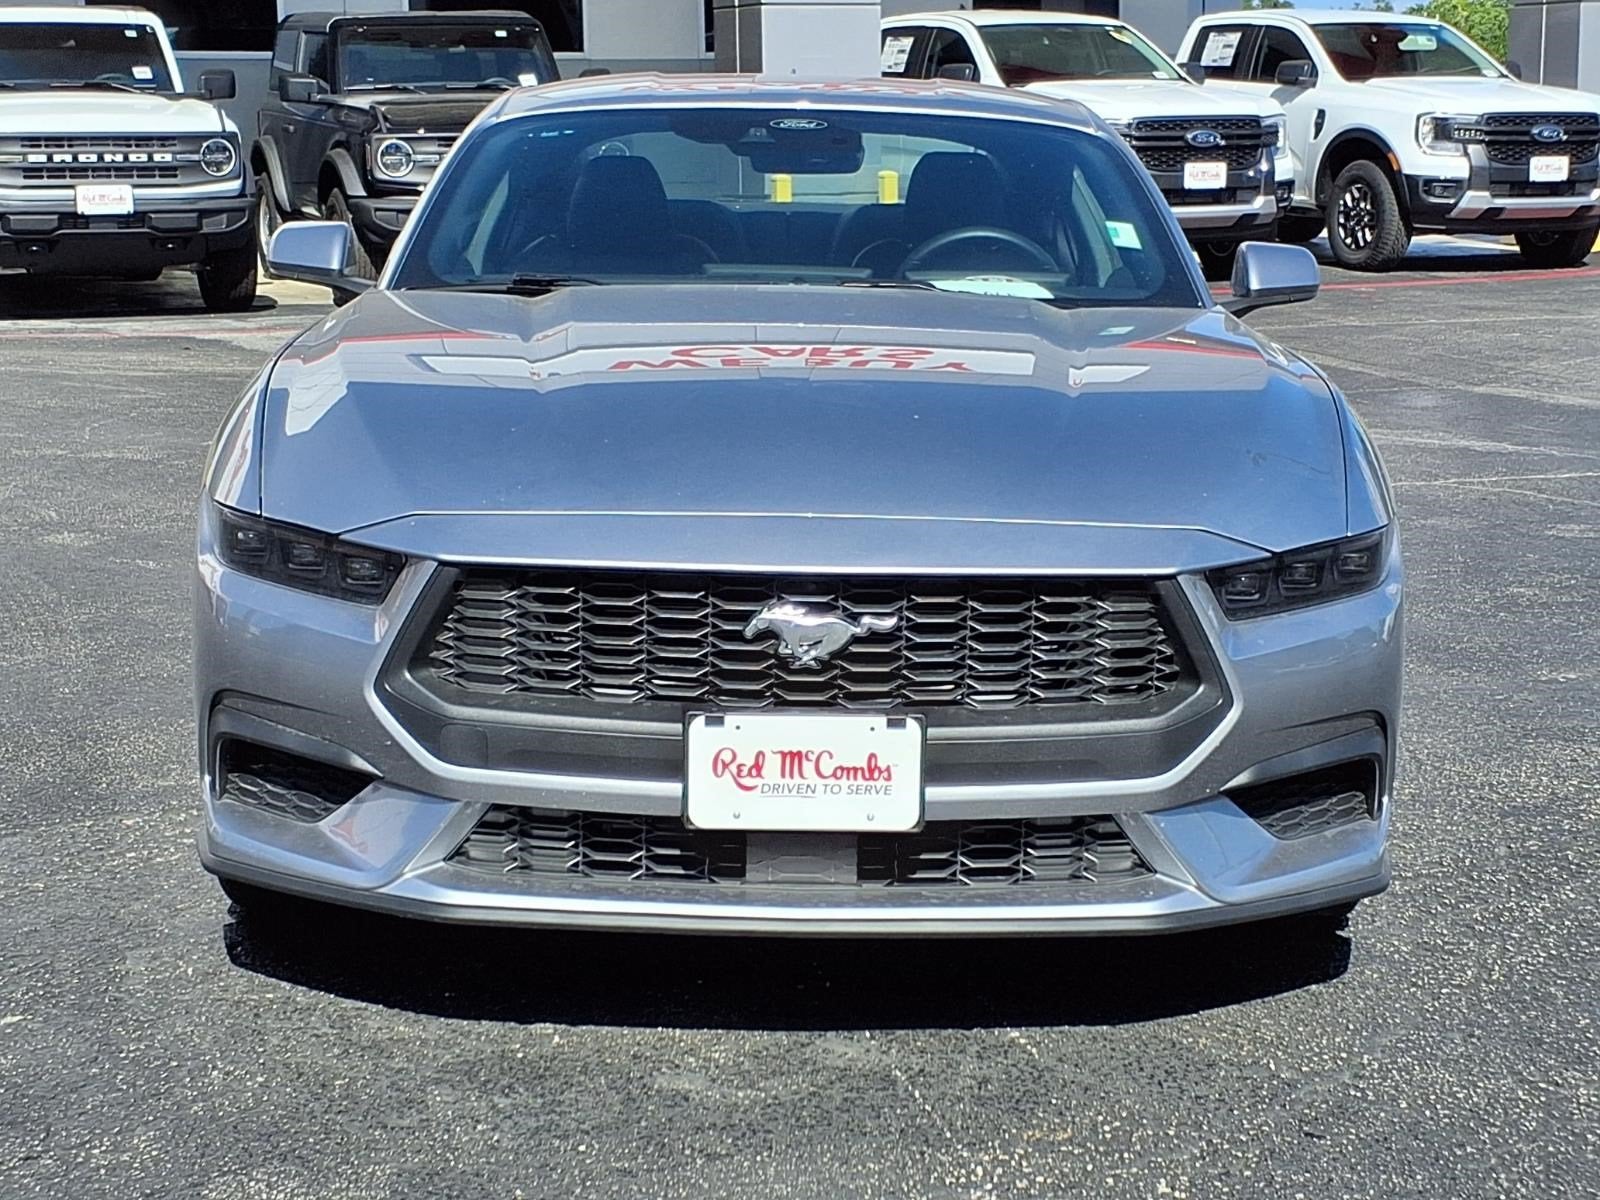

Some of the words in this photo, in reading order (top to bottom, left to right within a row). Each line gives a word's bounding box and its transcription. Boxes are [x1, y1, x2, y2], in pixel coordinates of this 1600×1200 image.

[27, 153, 173, 163] BRONCO
[712, 747, 765, 792] Red
[771, 749, 893, 782] McCombs
[760, 783, 817, 795] DRIVEN
[822, 784, 843, 795] TO
[846, 784, 893, 796] SERVE
